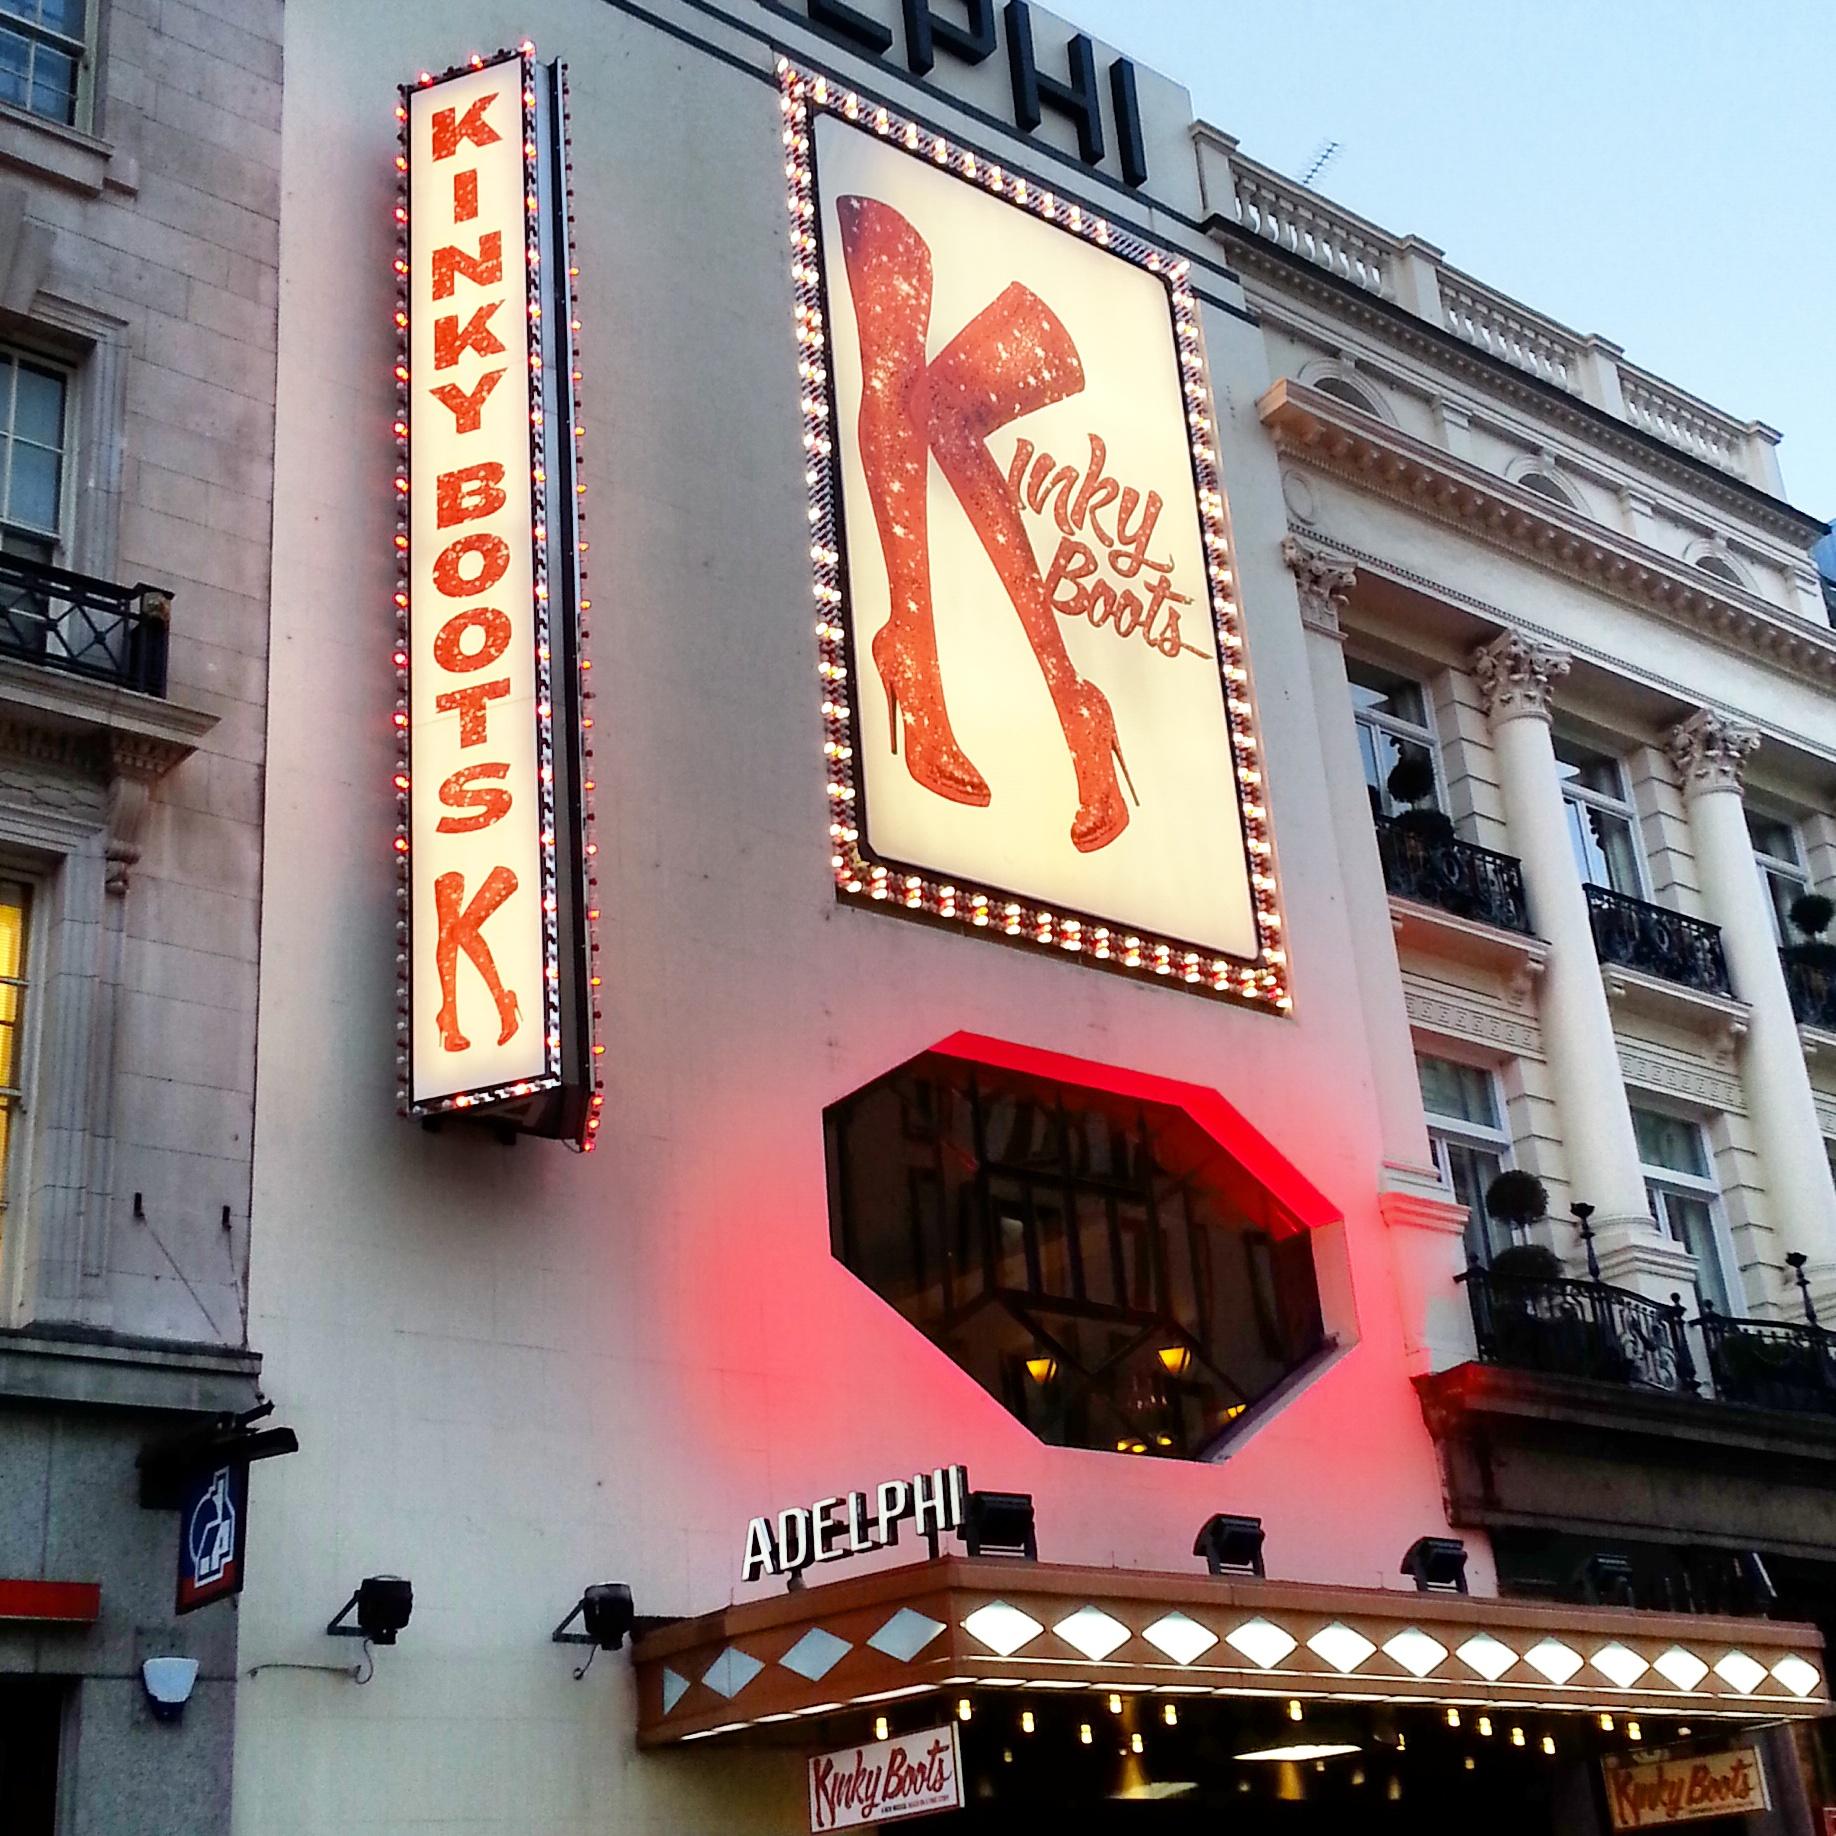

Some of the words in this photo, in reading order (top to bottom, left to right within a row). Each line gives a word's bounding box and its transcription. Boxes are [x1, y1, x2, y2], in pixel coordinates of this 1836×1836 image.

[428, 91, 508, 435] KINKY
[431, 460, 513, 834] BOOTS
[1045, 535, 1214, 658] Boots
[741, 1464, 968, 1582] ADELPHI
[813, 1748, 882, 1827] Kinky
[881, 1739, 952, 1802] Boots
